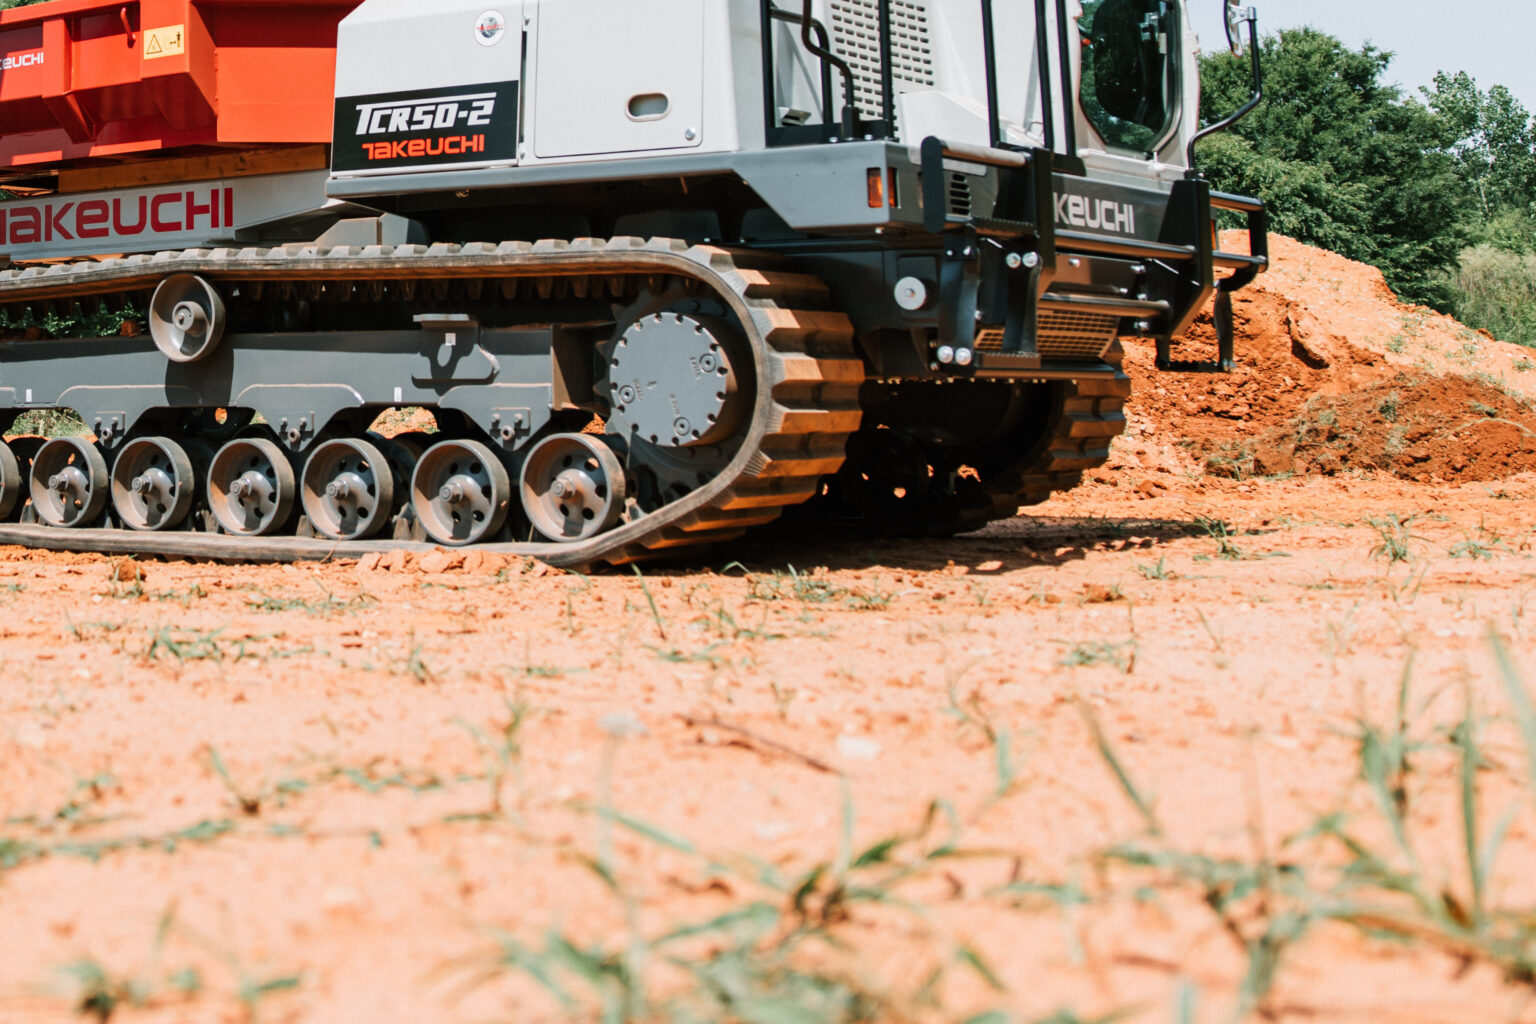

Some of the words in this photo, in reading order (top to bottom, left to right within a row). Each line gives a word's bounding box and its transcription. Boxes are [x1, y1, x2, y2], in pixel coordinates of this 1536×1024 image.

[355, 91, 497, 136] TCR50-2
[361, 134, 485, 160] TAKEUCHI
[1052, 191, 1135, 234] KEUCHI
